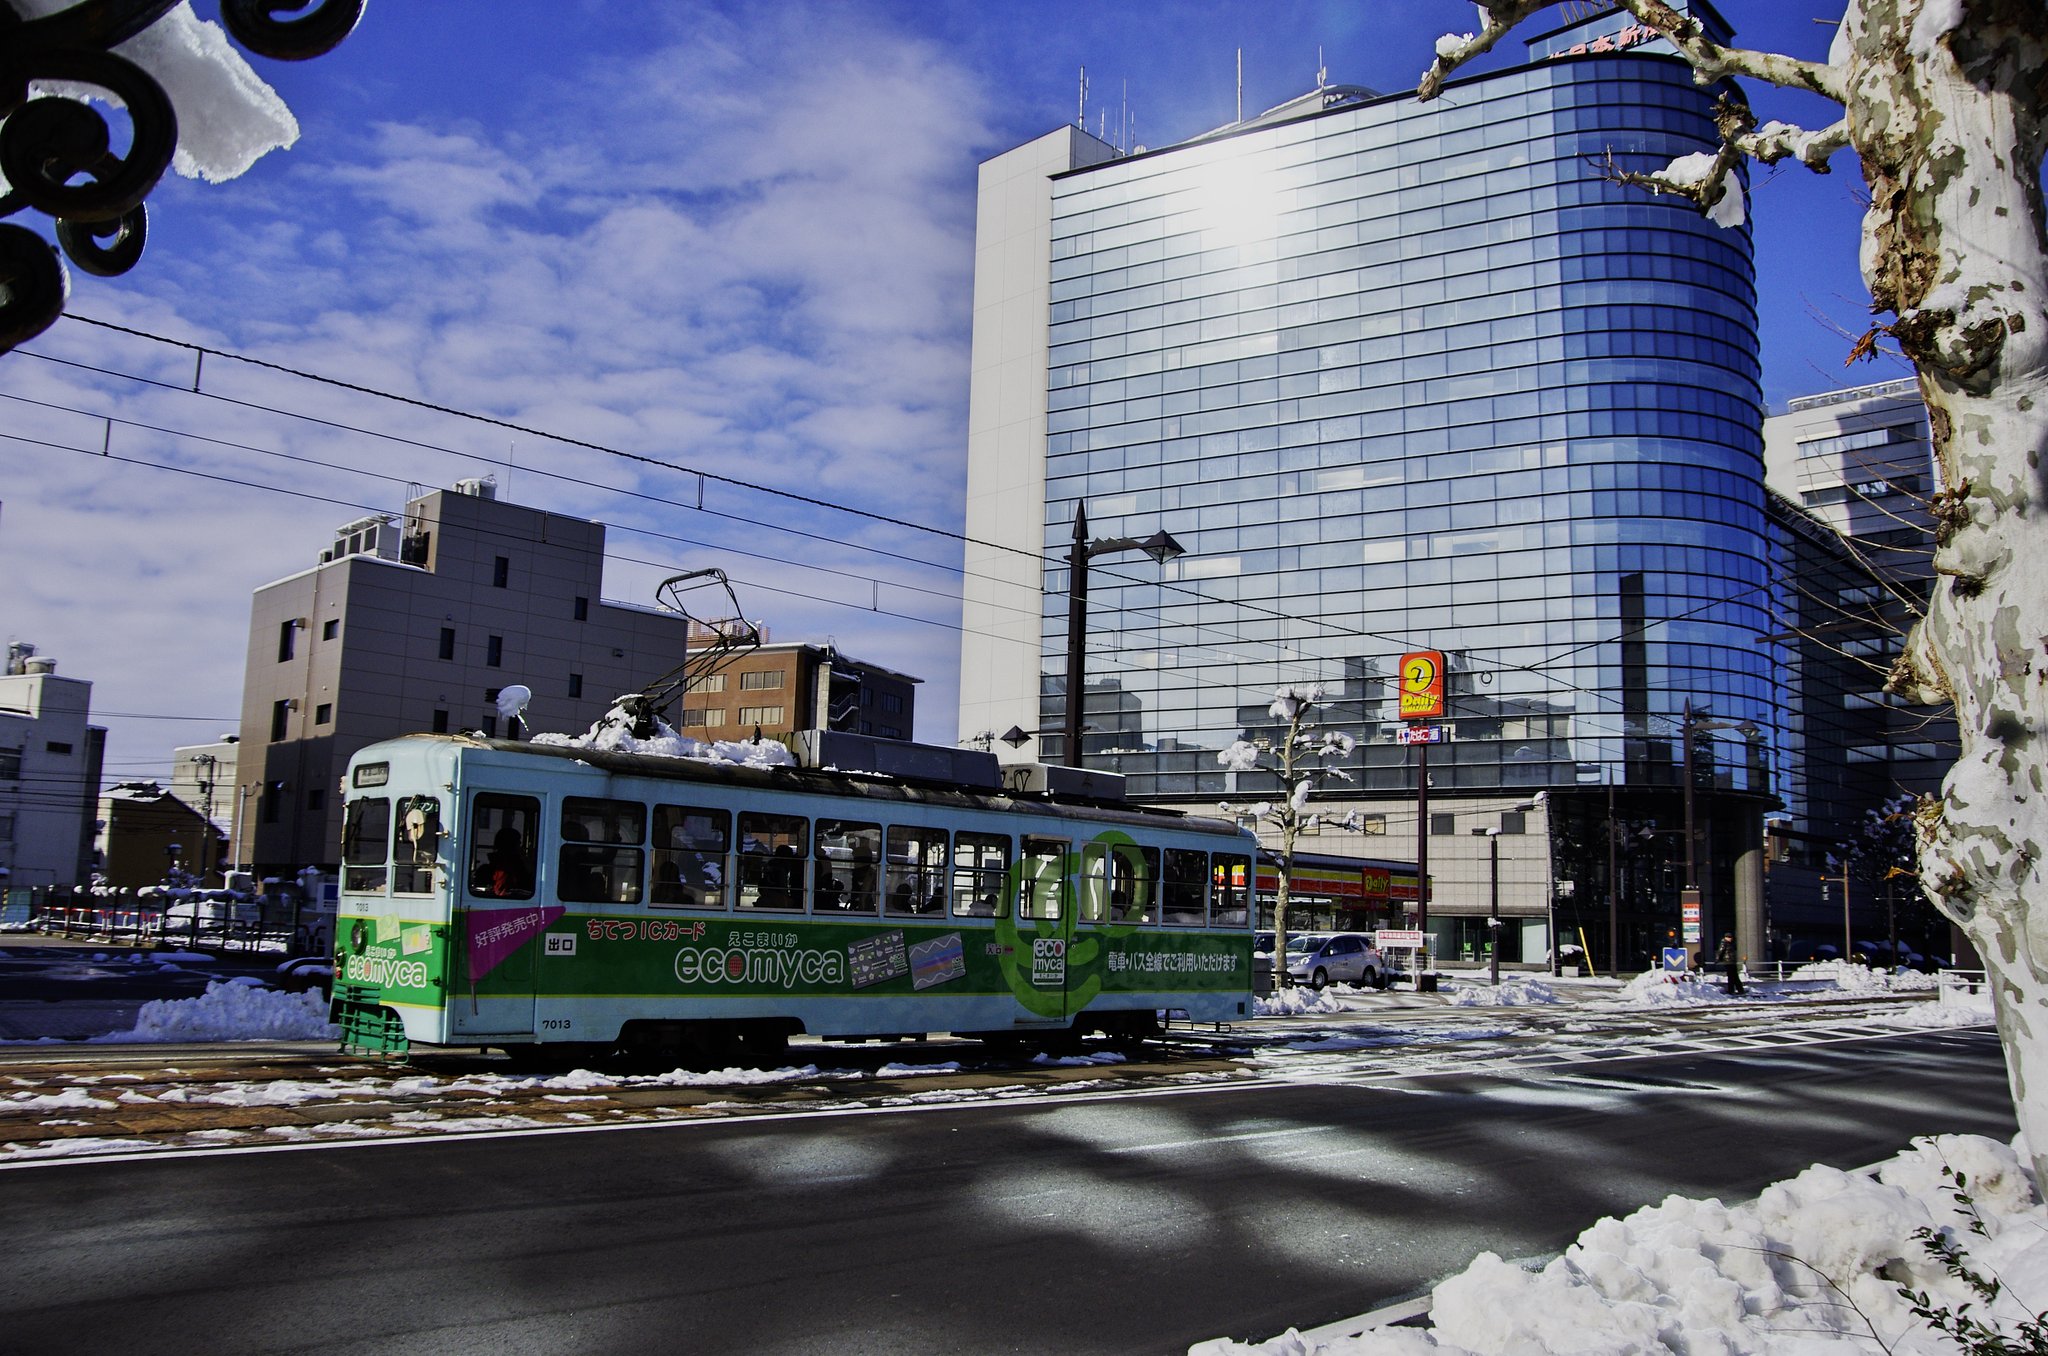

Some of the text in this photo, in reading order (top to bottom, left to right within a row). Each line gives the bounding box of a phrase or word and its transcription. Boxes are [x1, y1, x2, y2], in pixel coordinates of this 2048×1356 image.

[1401, 692, 1440, 710] Daily
[548, 938, 573, 951] 出口
[728, 931, 798, 948] えこまいか
[1035, 940, 1064, 957] eco
[347, 954, 427, 988] ecomyca
[674, 946, 844, 989] ecomyca
[1034, 958, 1063, 972] myca
[542, 1020, 571, 1030] 7013
